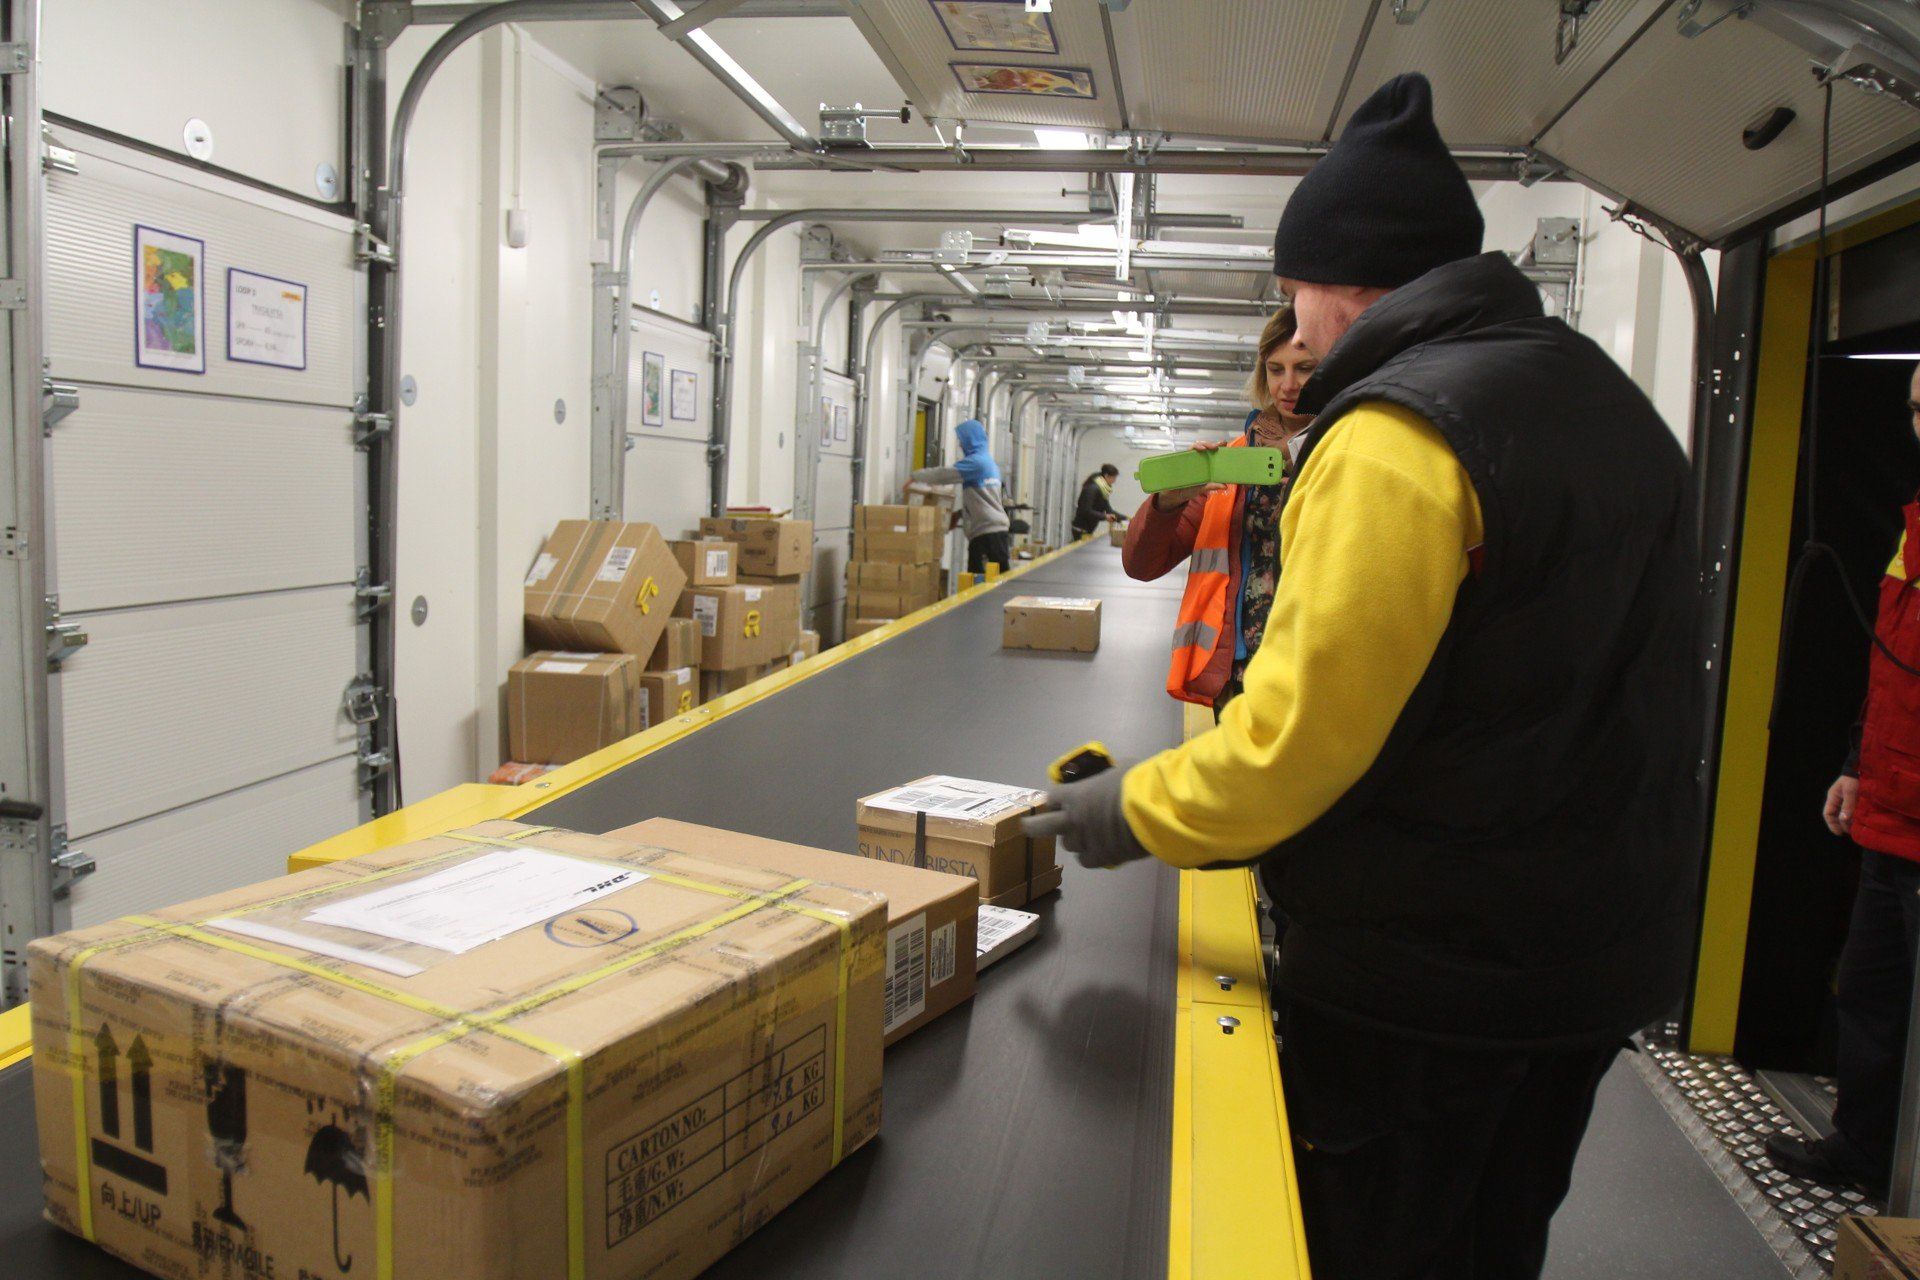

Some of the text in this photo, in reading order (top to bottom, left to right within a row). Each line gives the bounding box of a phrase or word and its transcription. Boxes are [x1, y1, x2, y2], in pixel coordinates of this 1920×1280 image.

[803, 1060, 819, 1086] KG
[802, 1086, 818, 1113] KG
[617, 1106, 706, 1172] CARTON NO:
